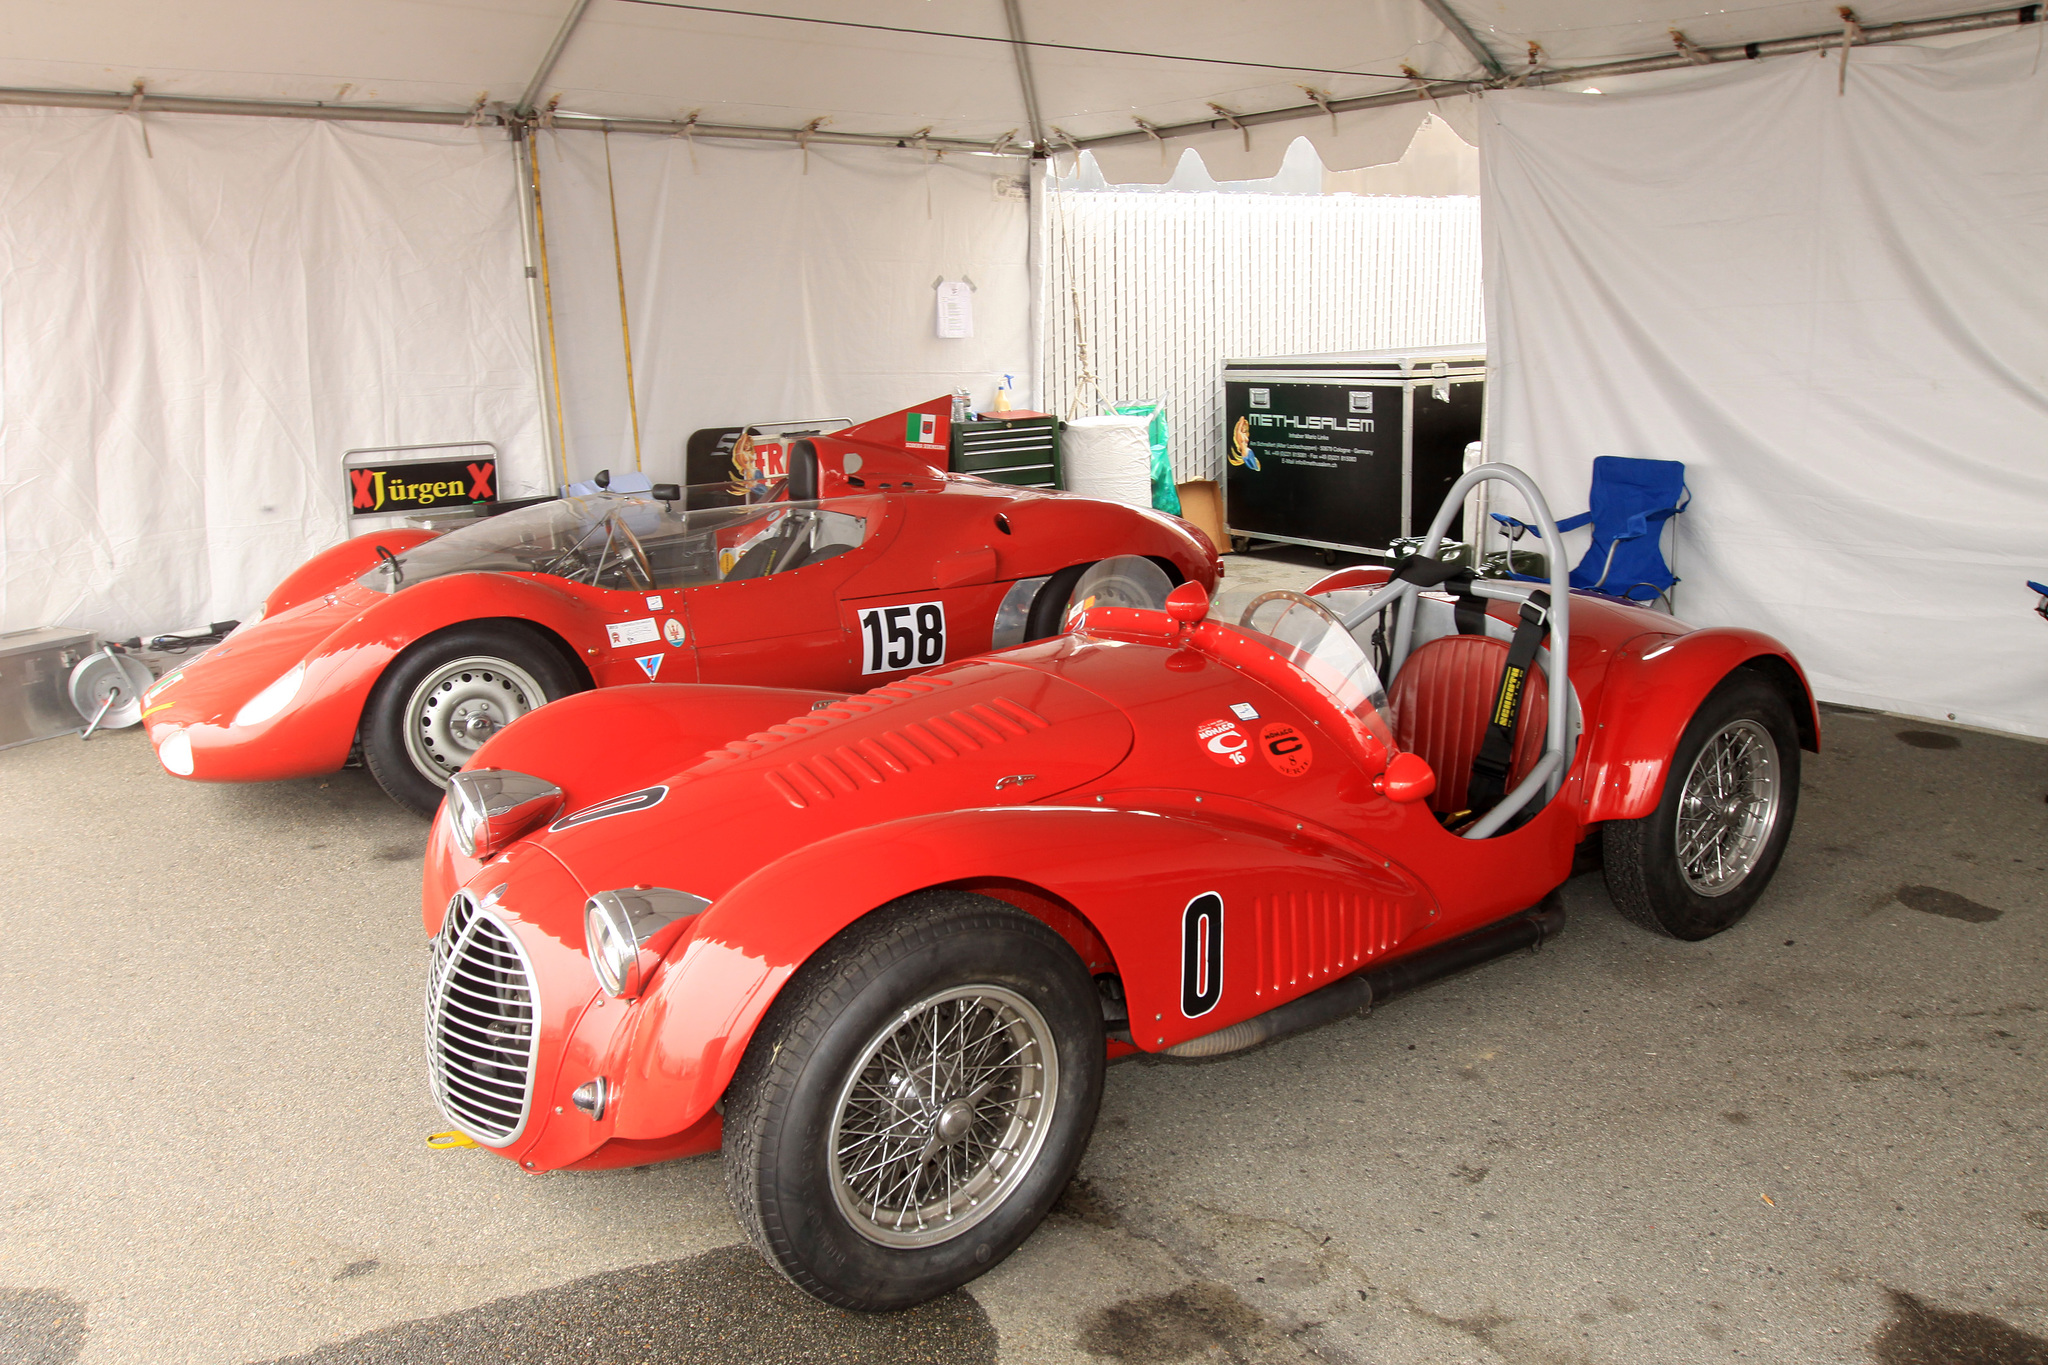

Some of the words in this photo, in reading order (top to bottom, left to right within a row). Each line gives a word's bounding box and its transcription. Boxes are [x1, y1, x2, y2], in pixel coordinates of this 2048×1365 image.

[1249, 413, 1374, 432] METHUSALEM
[372, 471, 466, 511] Jürgen
[863, 604, 943, 671] 158
[1198, 722, 1236, 740] MONACO
[1265, 728, 1294, 740] MONACO
[1229, 751, 1246, 765] 16
[1181, 890, 1224, 1019] 0
